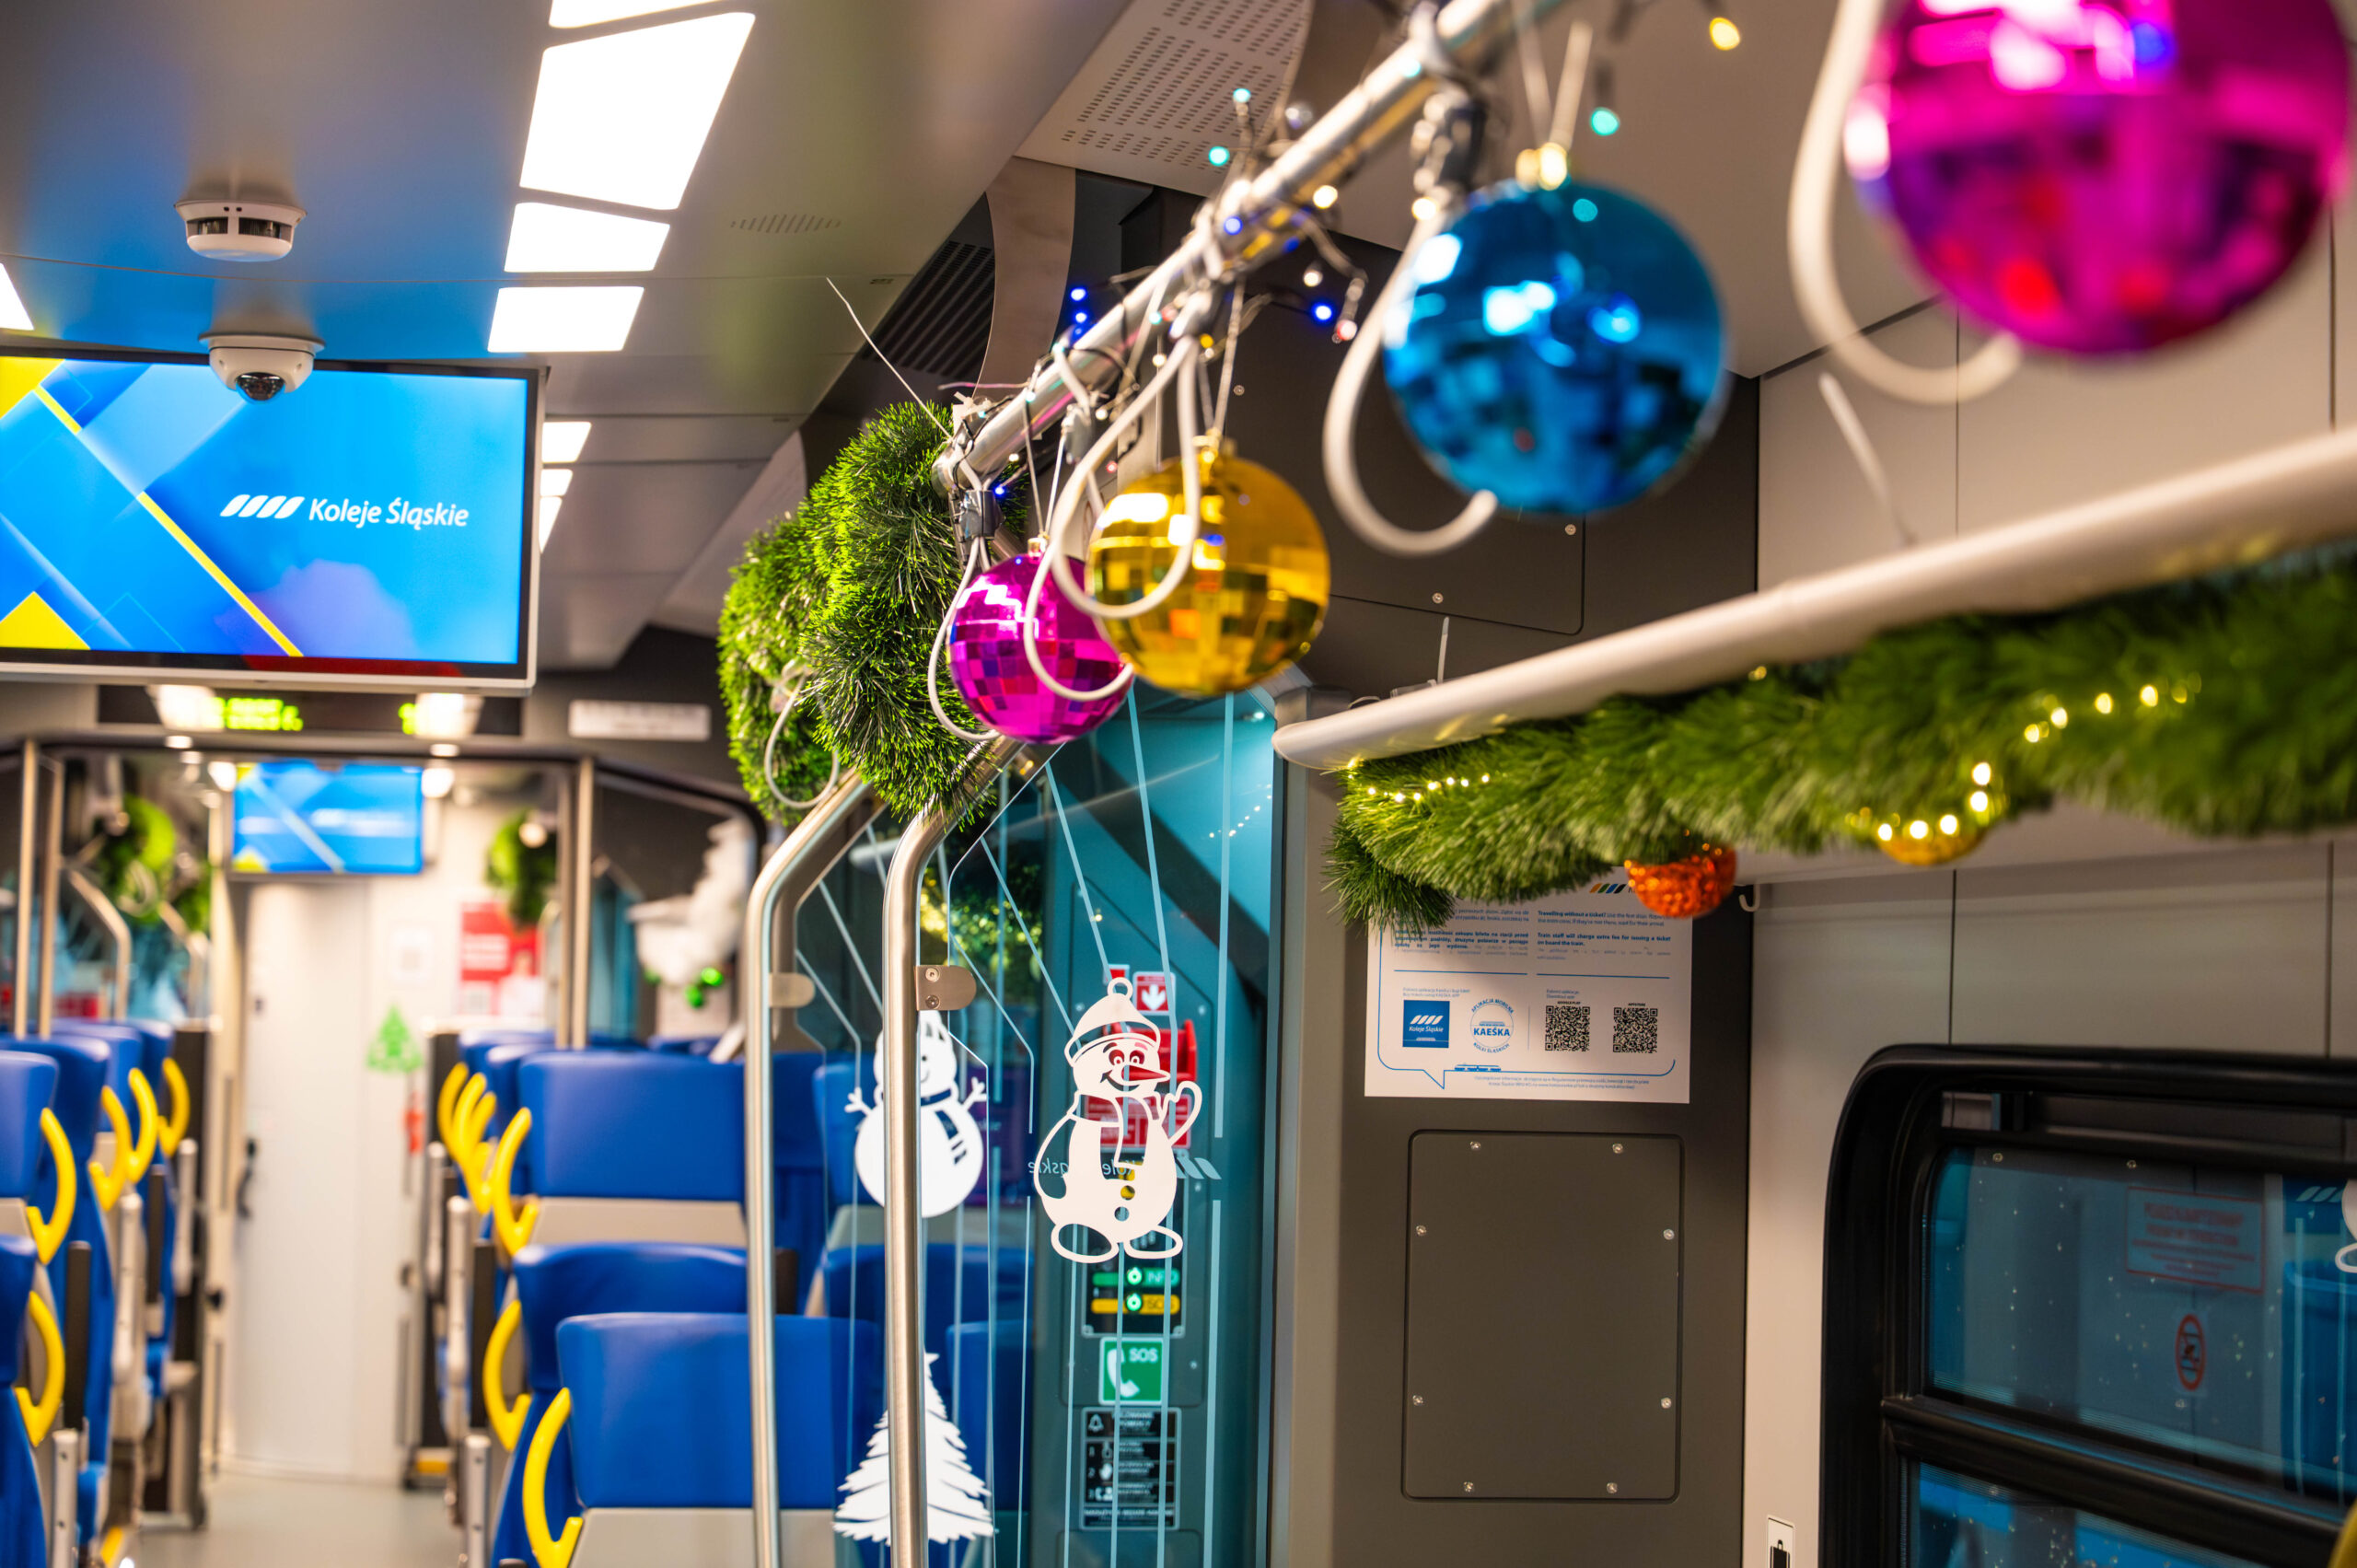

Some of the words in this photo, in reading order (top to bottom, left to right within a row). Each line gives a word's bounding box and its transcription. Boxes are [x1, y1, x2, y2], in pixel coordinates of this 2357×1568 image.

[308, 498, 382, 528] Koleje
[385, 497, 469, 530] Śląskie
[1471, 998, 1493, 1012] APLIKACJA
[1495, 999, 1515, 1014] MOBILNA
[1409, 1025, 1424, 1033] Koleje
[1425, 1025, 1444, 1033] Śląskie
[1473, 1027, 1510, 1036] KAEŚKA
[1129, 1347, 1159, 1363] SOS
